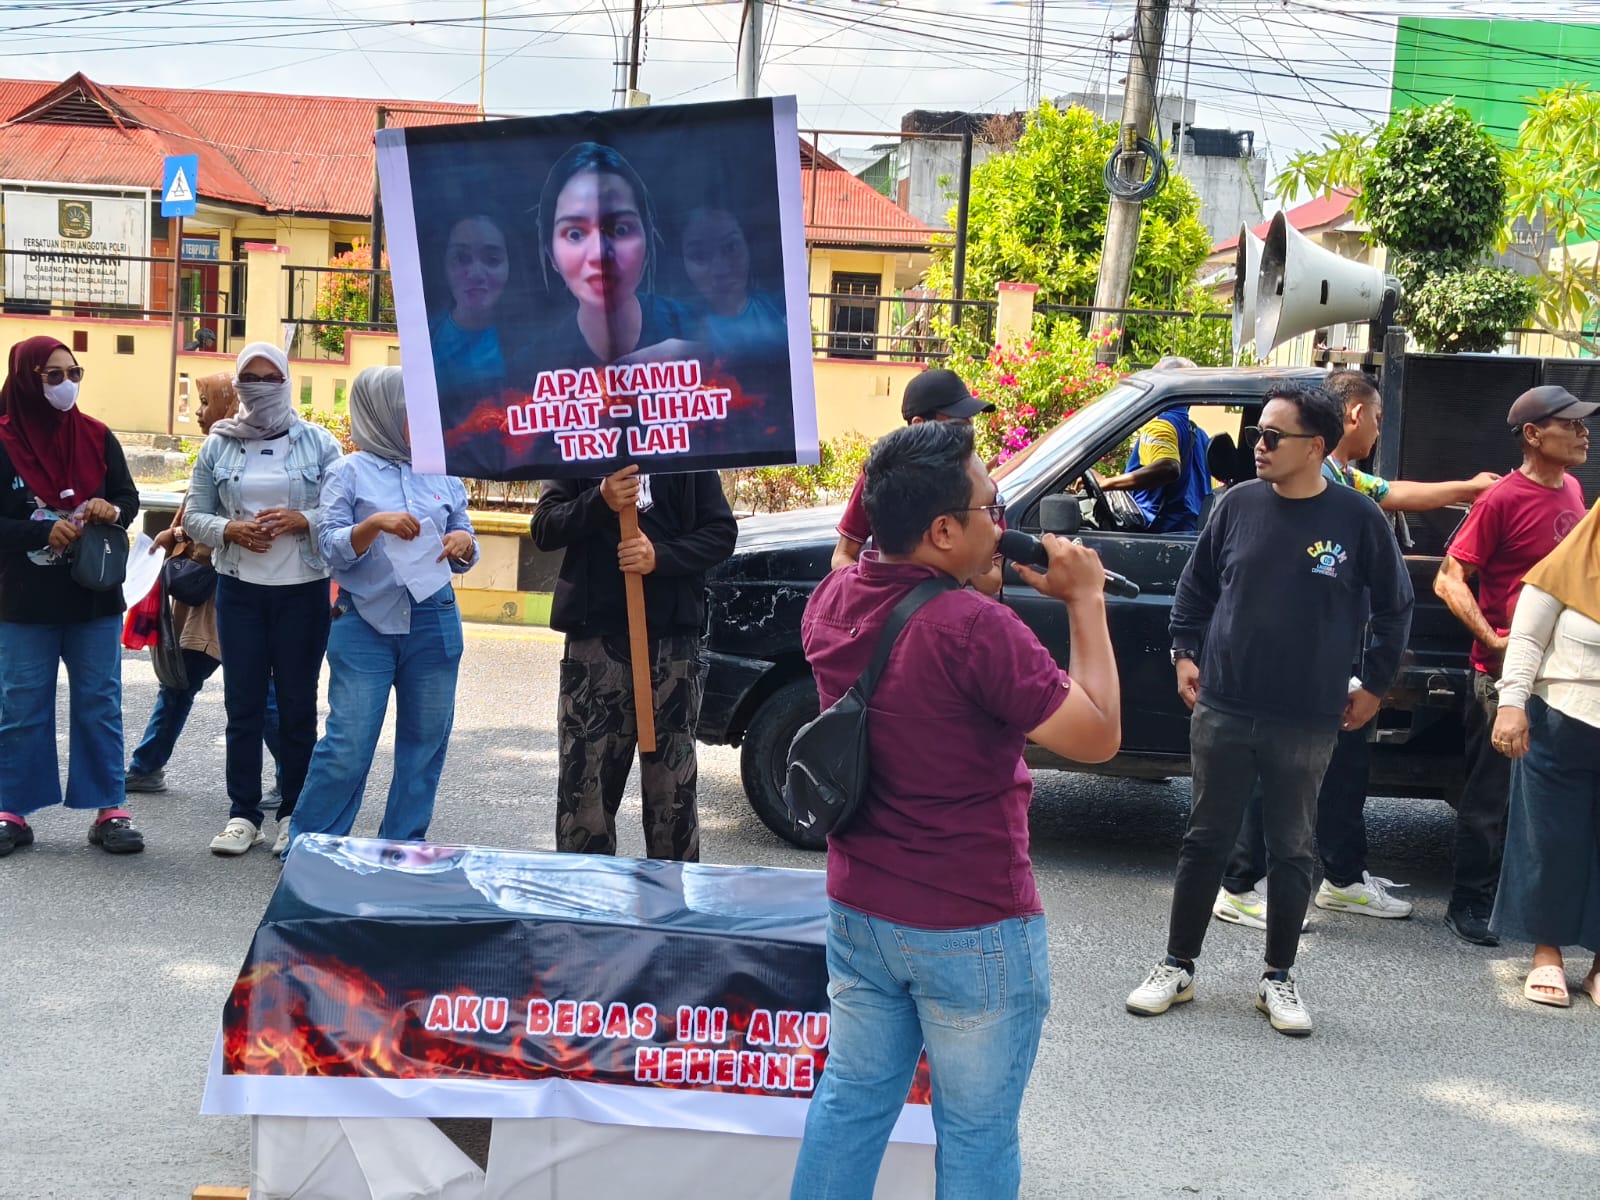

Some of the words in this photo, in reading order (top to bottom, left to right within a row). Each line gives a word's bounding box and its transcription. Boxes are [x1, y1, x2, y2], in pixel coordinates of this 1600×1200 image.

[23, 237, 59, 249] PERSATUAN
[60, 239, 76, 249] ISTRI
[78, 240, 107, 251] ANGGOTA
[108, 242, 127, 252] POLRI
[35, 265, 63, 273] CABANG
[64, 266, 96, 275] TANJUNG
[533, 369, 602, 401] APA
[605, 360, 701, 396] KAMU
[507, 400, 603, 435] LIHAT
[638, 389, 731, 424] LIHAT
[554, 427, 622, 462] TRY
[627, 422, 690, 456] LAH
[942, 938, 977, 950] Jeep
[425, 995, 509, 1034] AKU
[526, 999, 657, 1040] BEBAS
[746, 1009, 830, 1049] AKU
